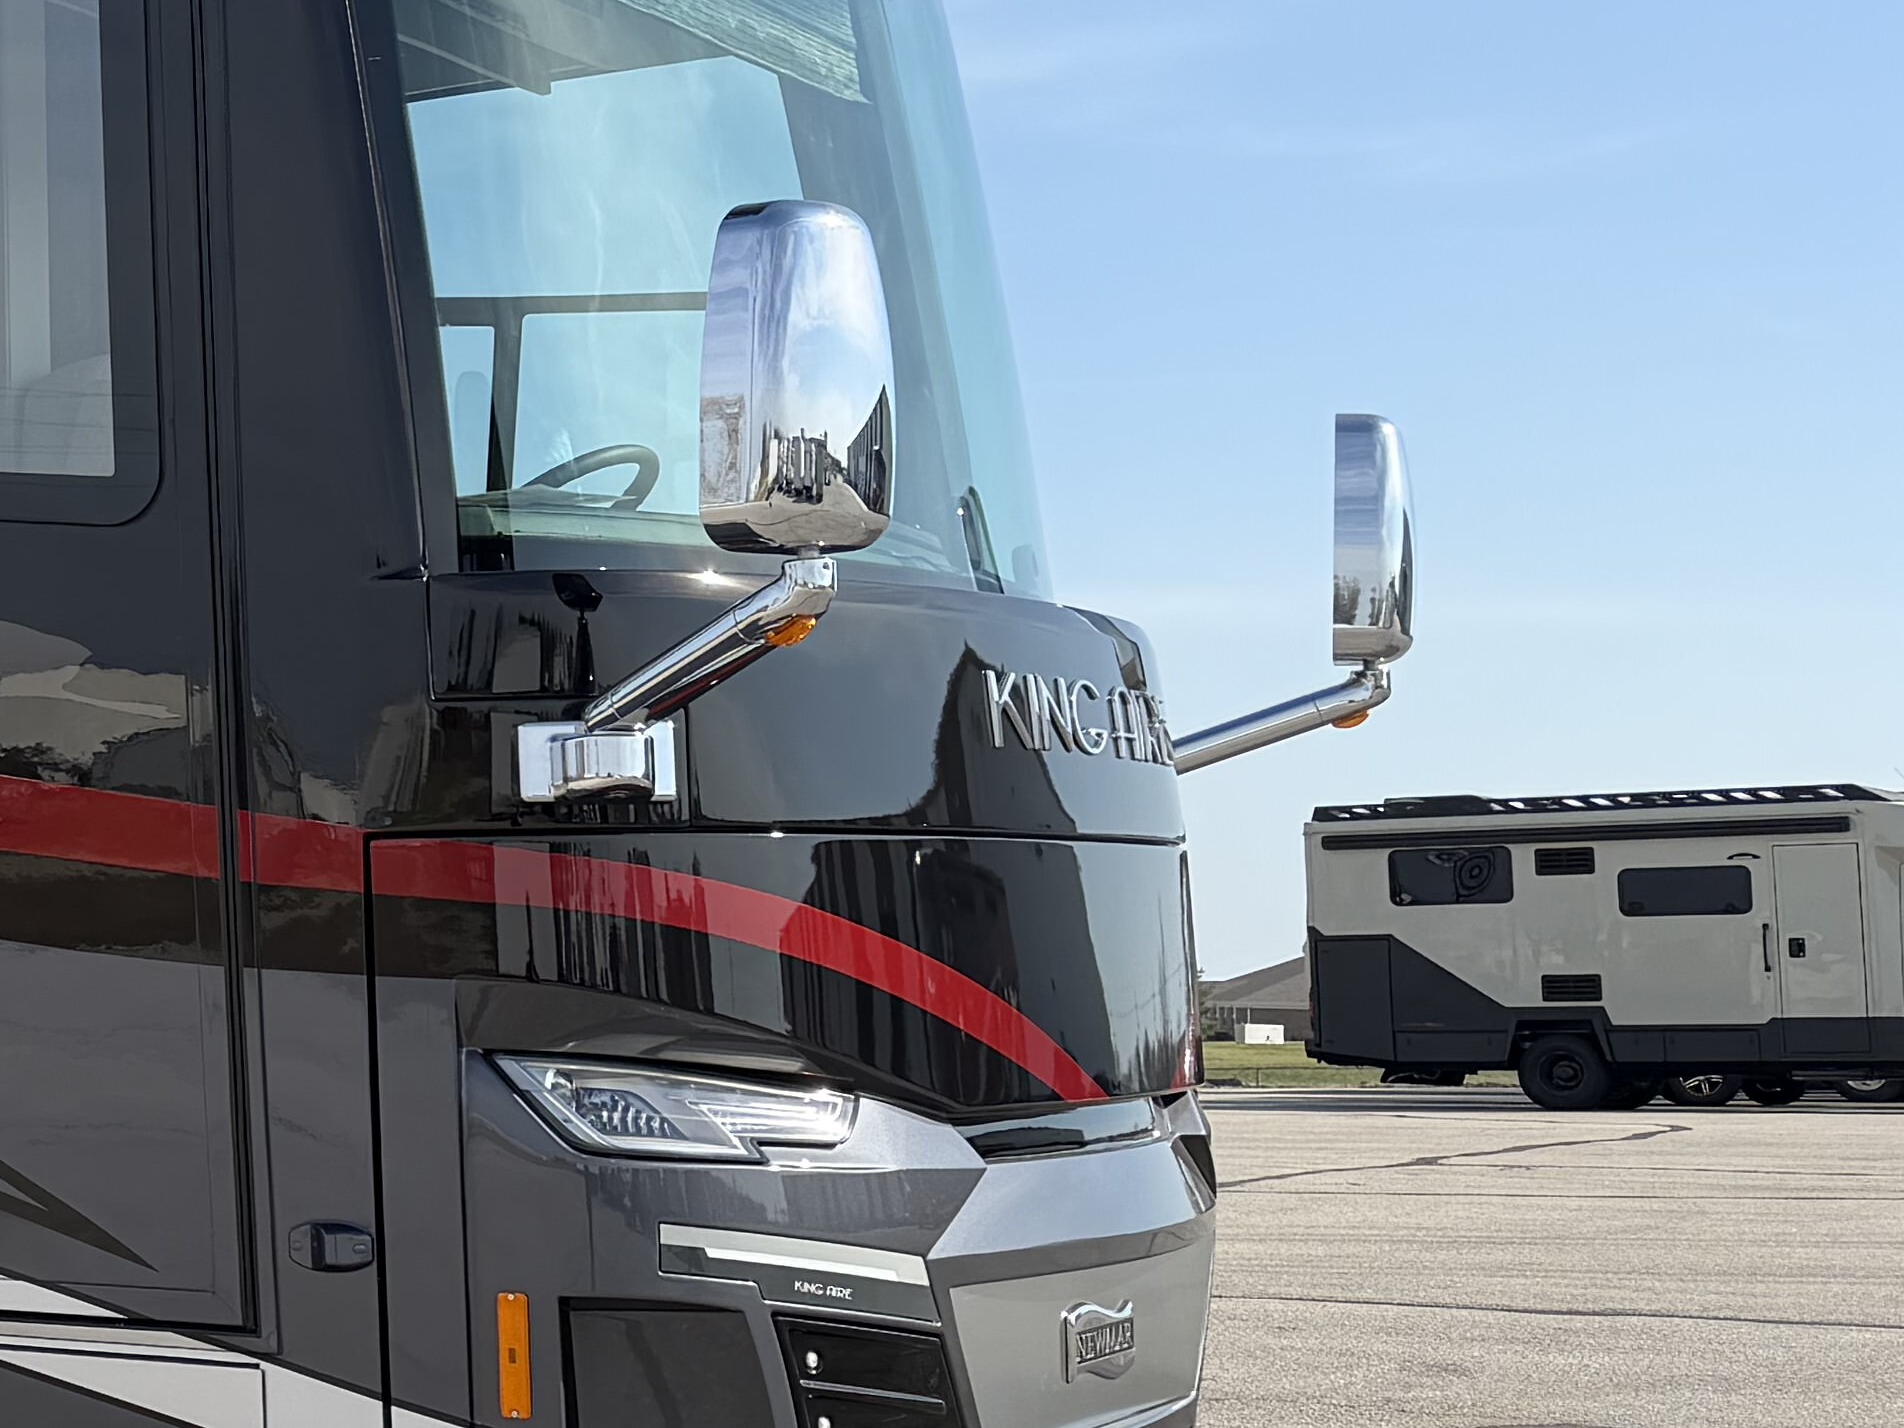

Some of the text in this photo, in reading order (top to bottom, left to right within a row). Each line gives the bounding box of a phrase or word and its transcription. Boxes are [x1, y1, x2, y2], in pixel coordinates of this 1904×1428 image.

[982, 669, 1109, 756] KING
[794, 1280, 853, 1300] KING AIRE
[1076, 1322, 1134, 1360] NEWMAR
